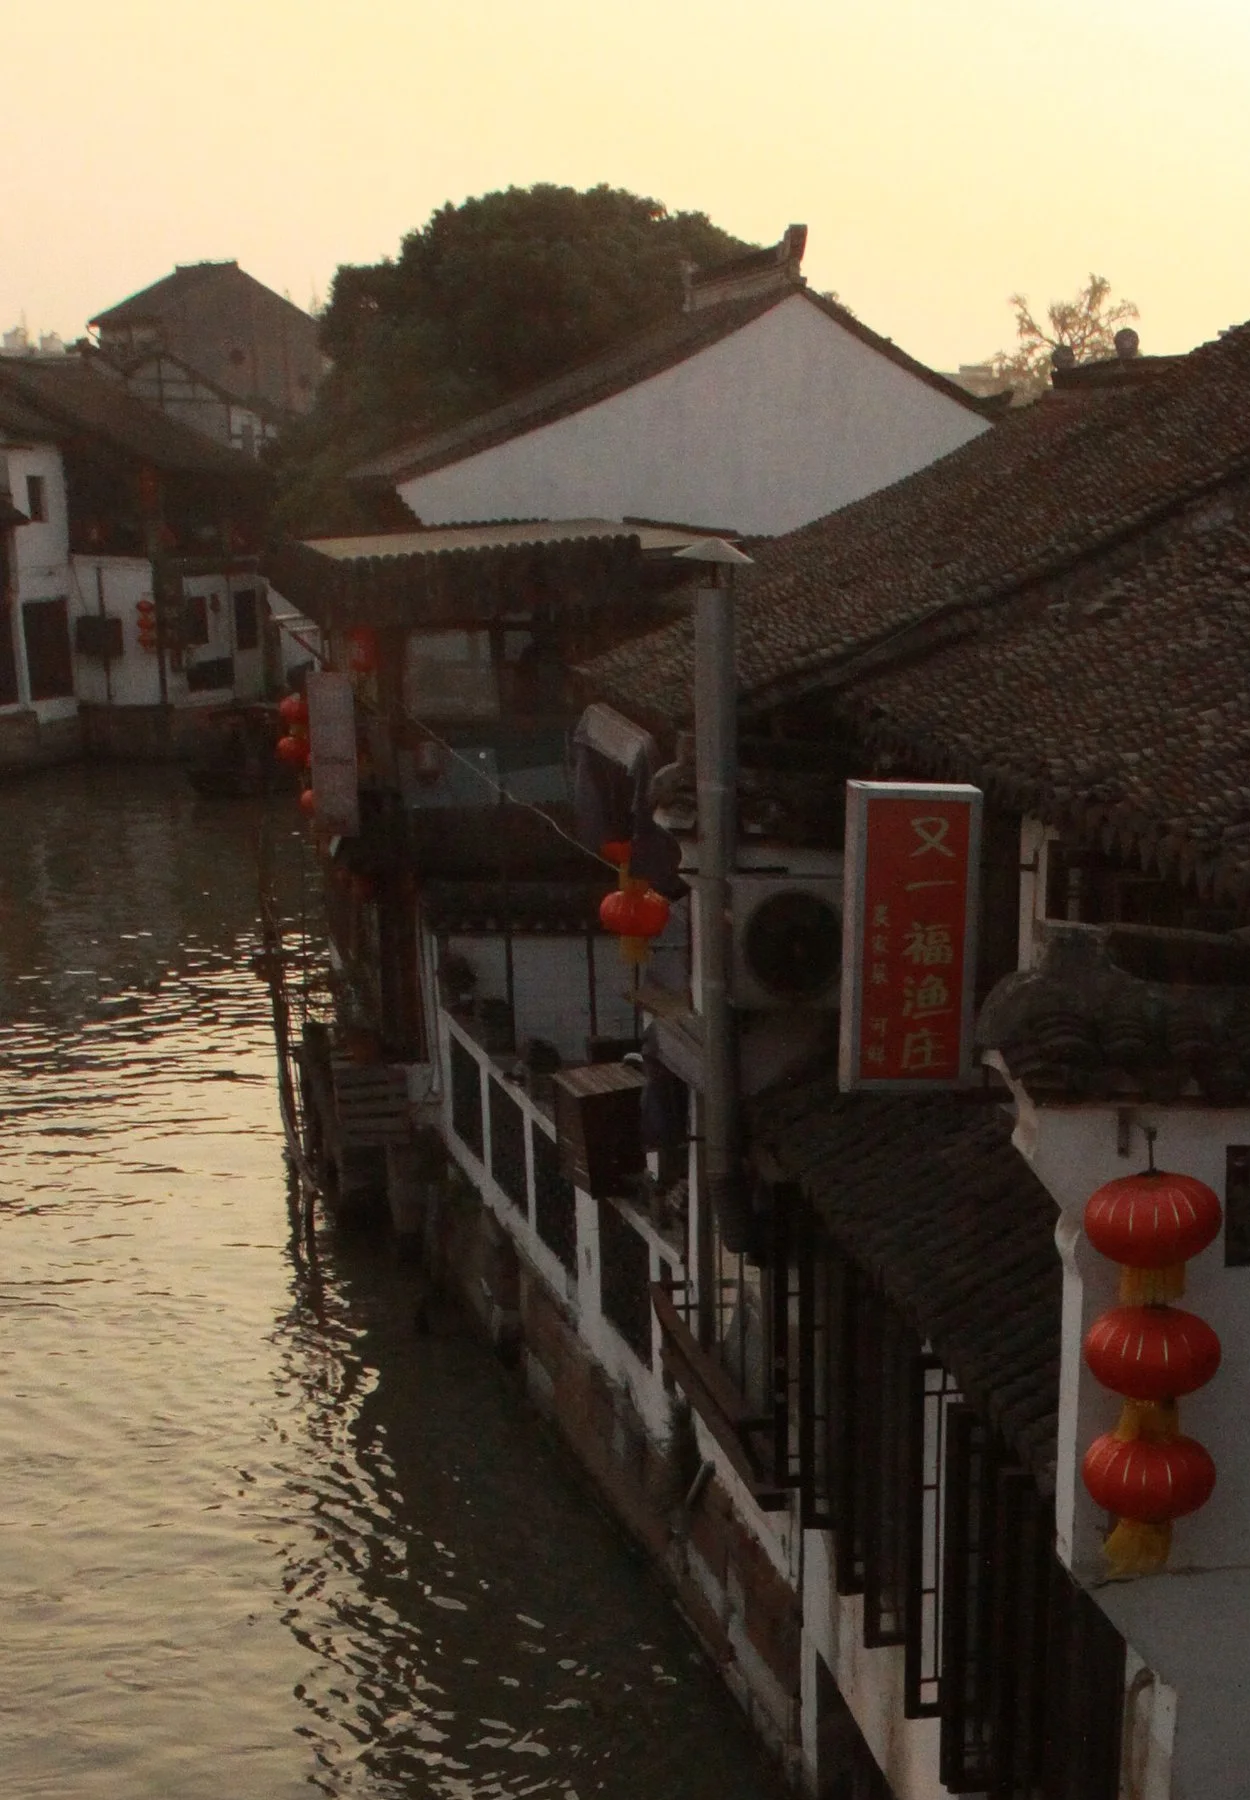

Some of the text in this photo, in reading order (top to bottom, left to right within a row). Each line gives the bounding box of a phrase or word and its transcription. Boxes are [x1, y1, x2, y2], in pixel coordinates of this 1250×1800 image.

[903, 816, 957, 1071] 又一福渔庄
